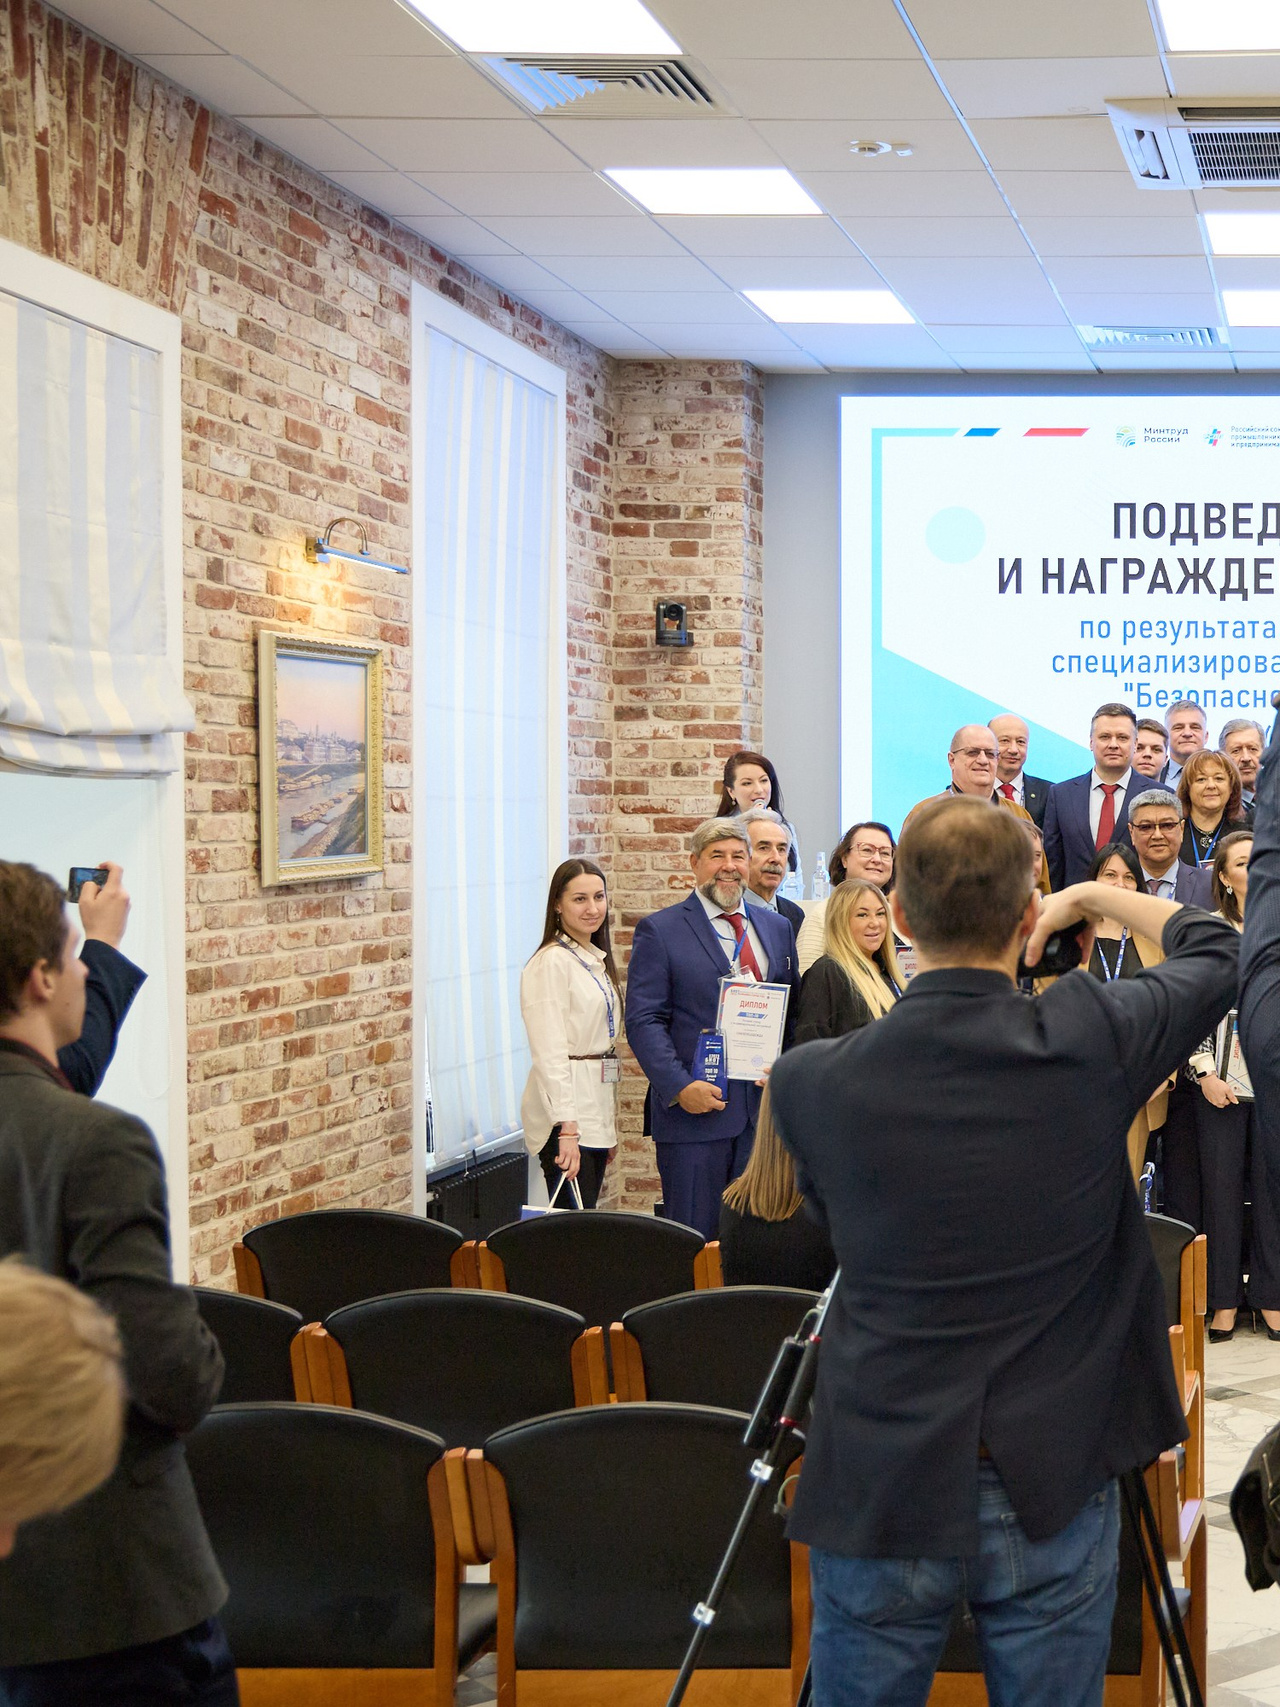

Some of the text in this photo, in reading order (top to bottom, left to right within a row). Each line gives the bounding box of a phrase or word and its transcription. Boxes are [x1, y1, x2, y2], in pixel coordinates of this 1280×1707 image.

[1144, 427, 1189, 436] Минтруд
[998, 557, 1022, 594] И
[1080, 620, 1111, 639] по
[740, 1000, 768, 1009] ДИПЛОМ
